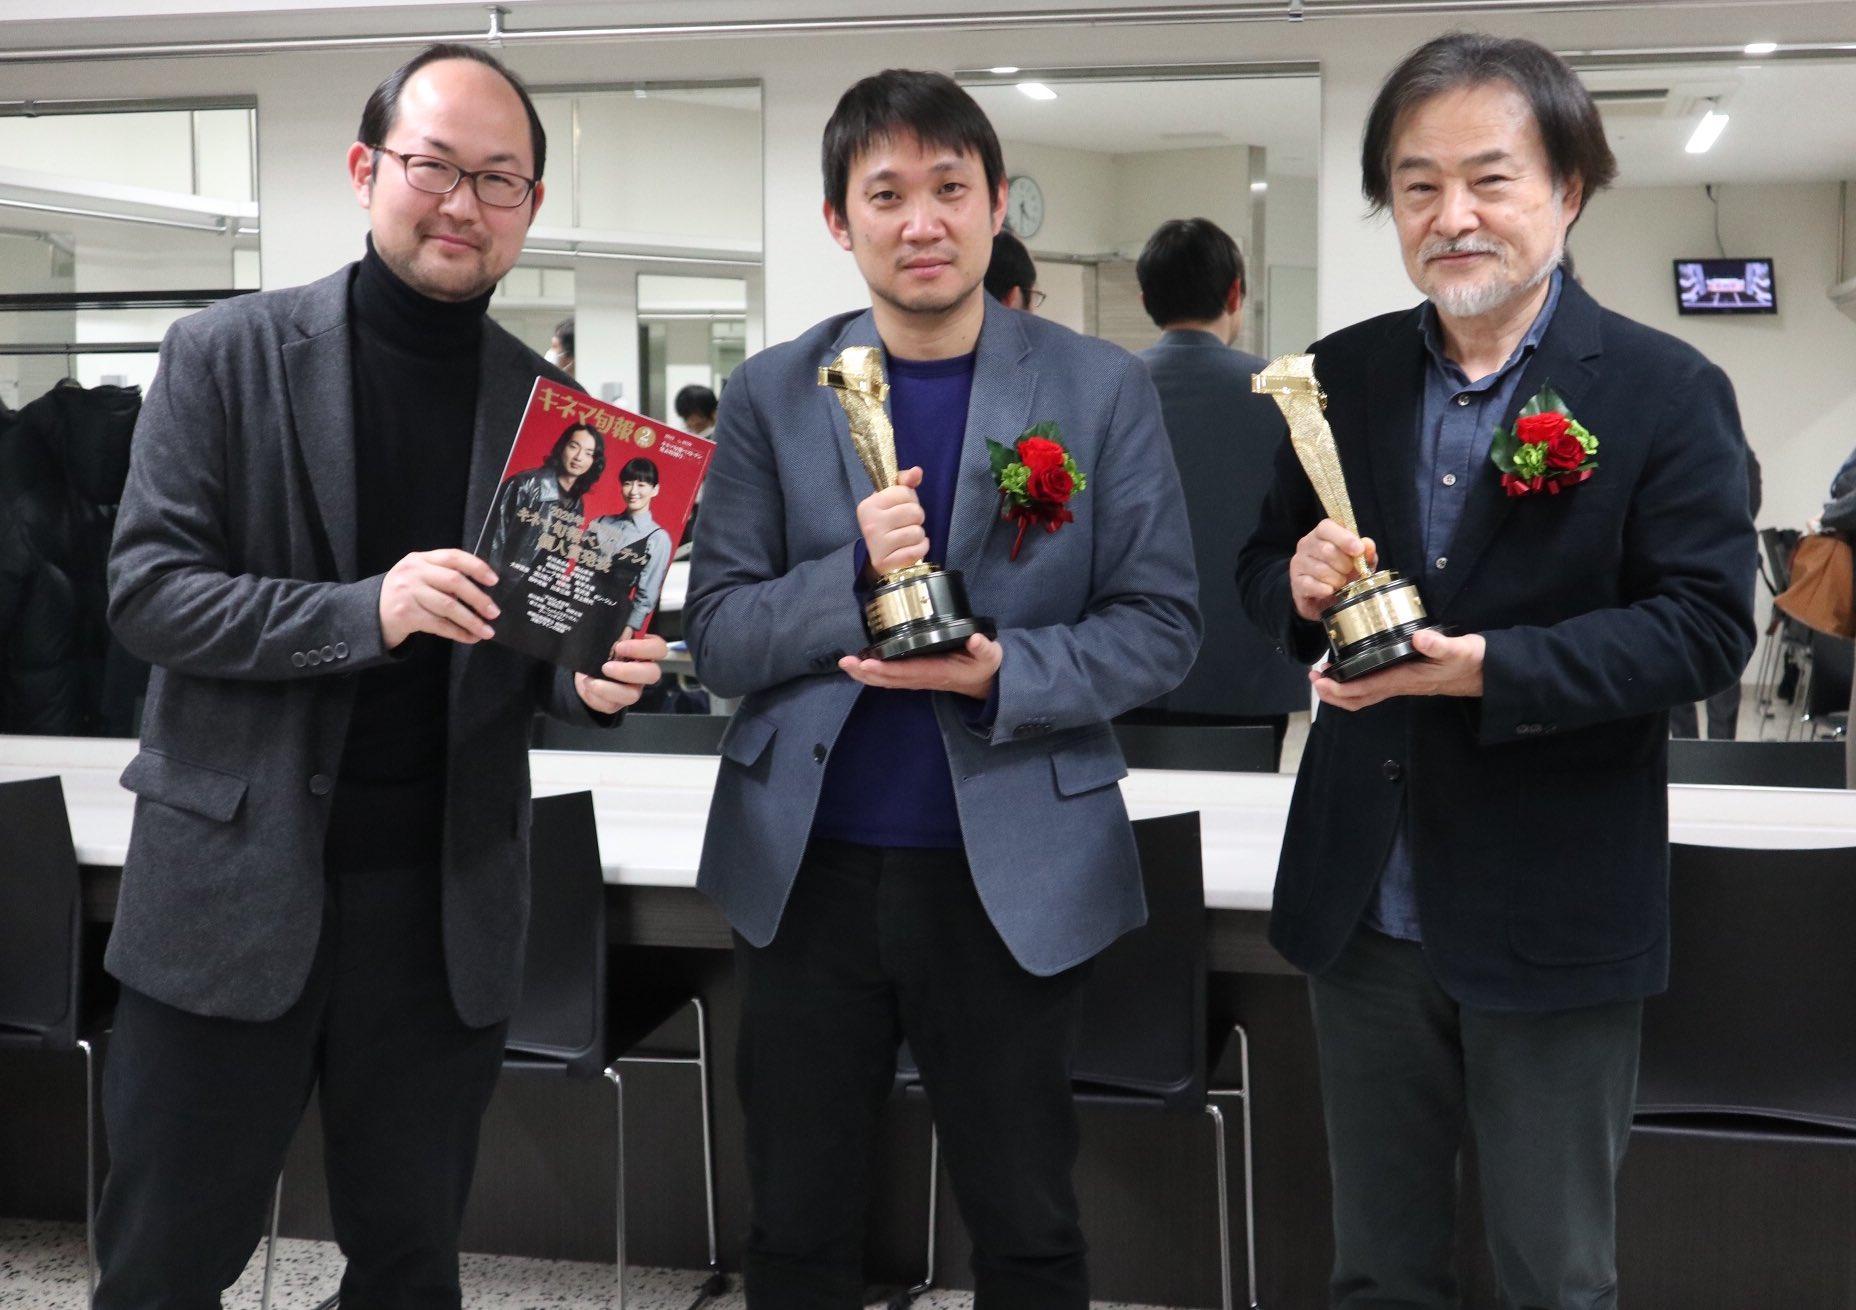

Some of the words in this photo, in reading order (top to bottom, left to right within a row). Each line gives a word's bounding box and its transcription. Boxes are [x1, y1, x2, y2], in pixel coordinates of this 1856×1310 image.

[538, 388, 636, 443] キネマ旬報
[639, 430, 650, 442] 2
